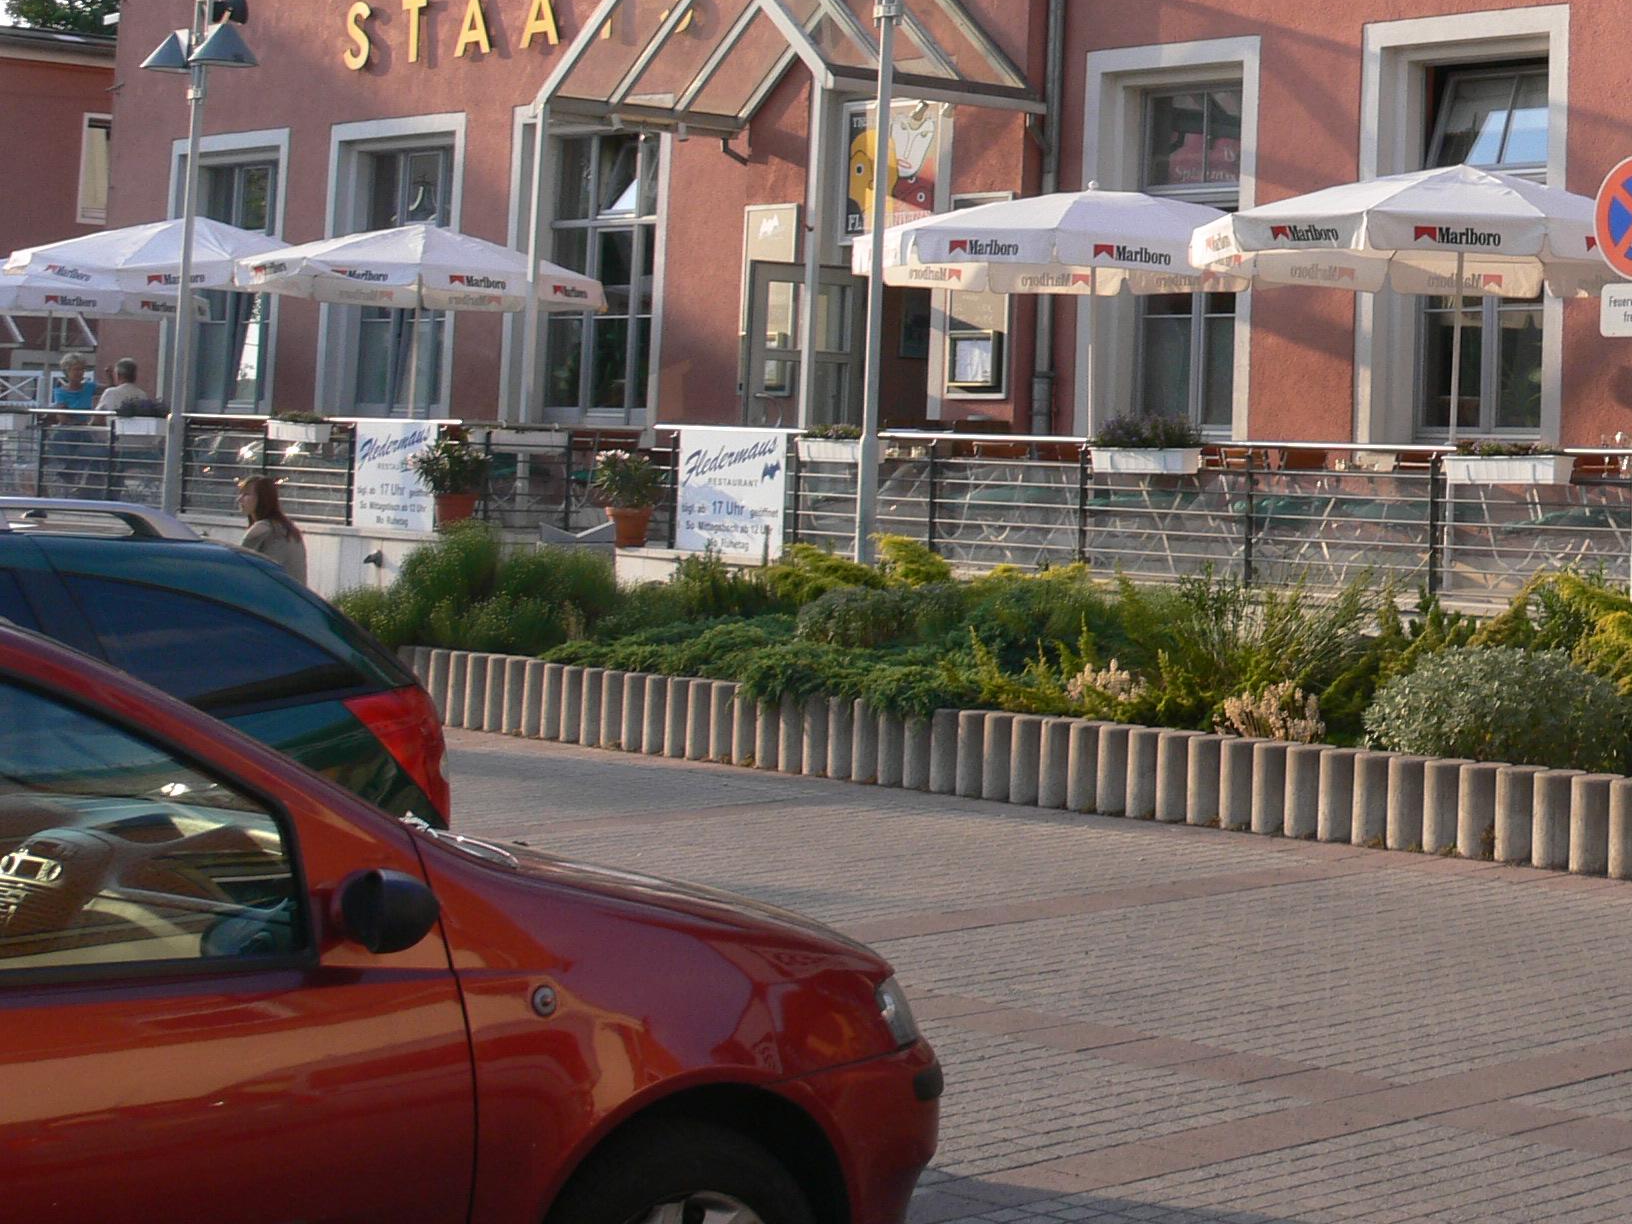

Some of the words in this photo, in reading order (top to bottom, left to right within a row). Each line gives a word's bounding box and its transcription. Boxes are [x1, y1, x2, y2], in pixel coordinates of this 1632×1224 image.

[1289, 224, 1339, 242] Marlboro
[1437, 226, 1502, 247] Marlboro
[968, 239, 1019, 256] Marlboro
[1115, 244, 1172, 266] Marlboro
[57, 265, 92, 282] Marlboro
[347, 269, 389, 282] Marlboro
[465, 275, 507, 290] Marlboro
[59, 295, 98, 308] Marlboro
[682, 436, 778, 488] Fledermaus
[391, 483, 406, 496] Uhr
[707, 477, 760, 488] RESTAURANT
[711, 500, 724, 516] 17
[726, 501, 745, 516] Uhr
